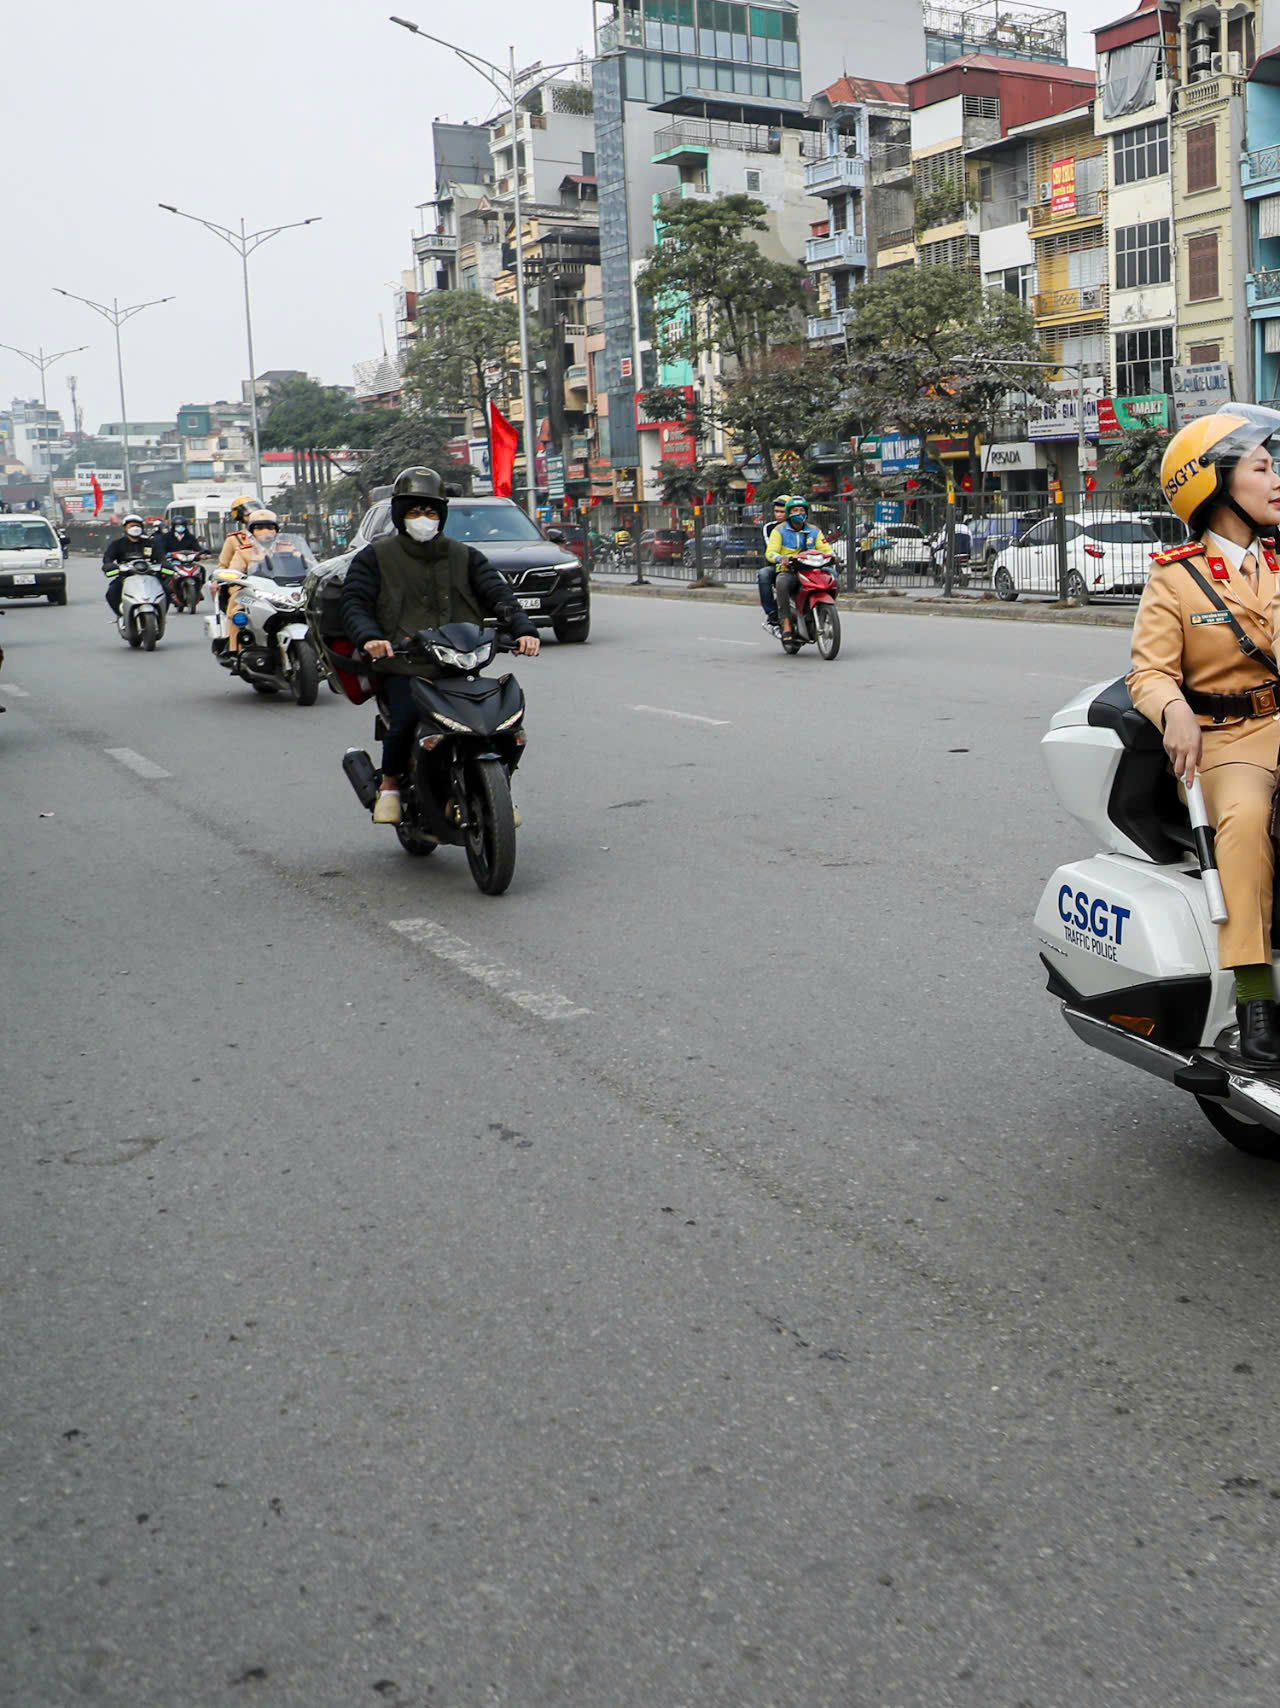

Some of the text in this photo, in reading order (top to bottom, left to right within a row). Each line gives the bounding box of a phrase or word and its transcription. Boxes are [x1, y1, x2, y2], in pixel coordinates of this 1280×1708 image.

[992, 450, 1021, 464] ROSADA
[1165, 458, 1199, 502] CSGT
[1058, 884, 1130, 945] C.S.G.T
[1064, 925, 1090, 950] TRAFFIC
[1092, 937, 1118, 962] POLICE
